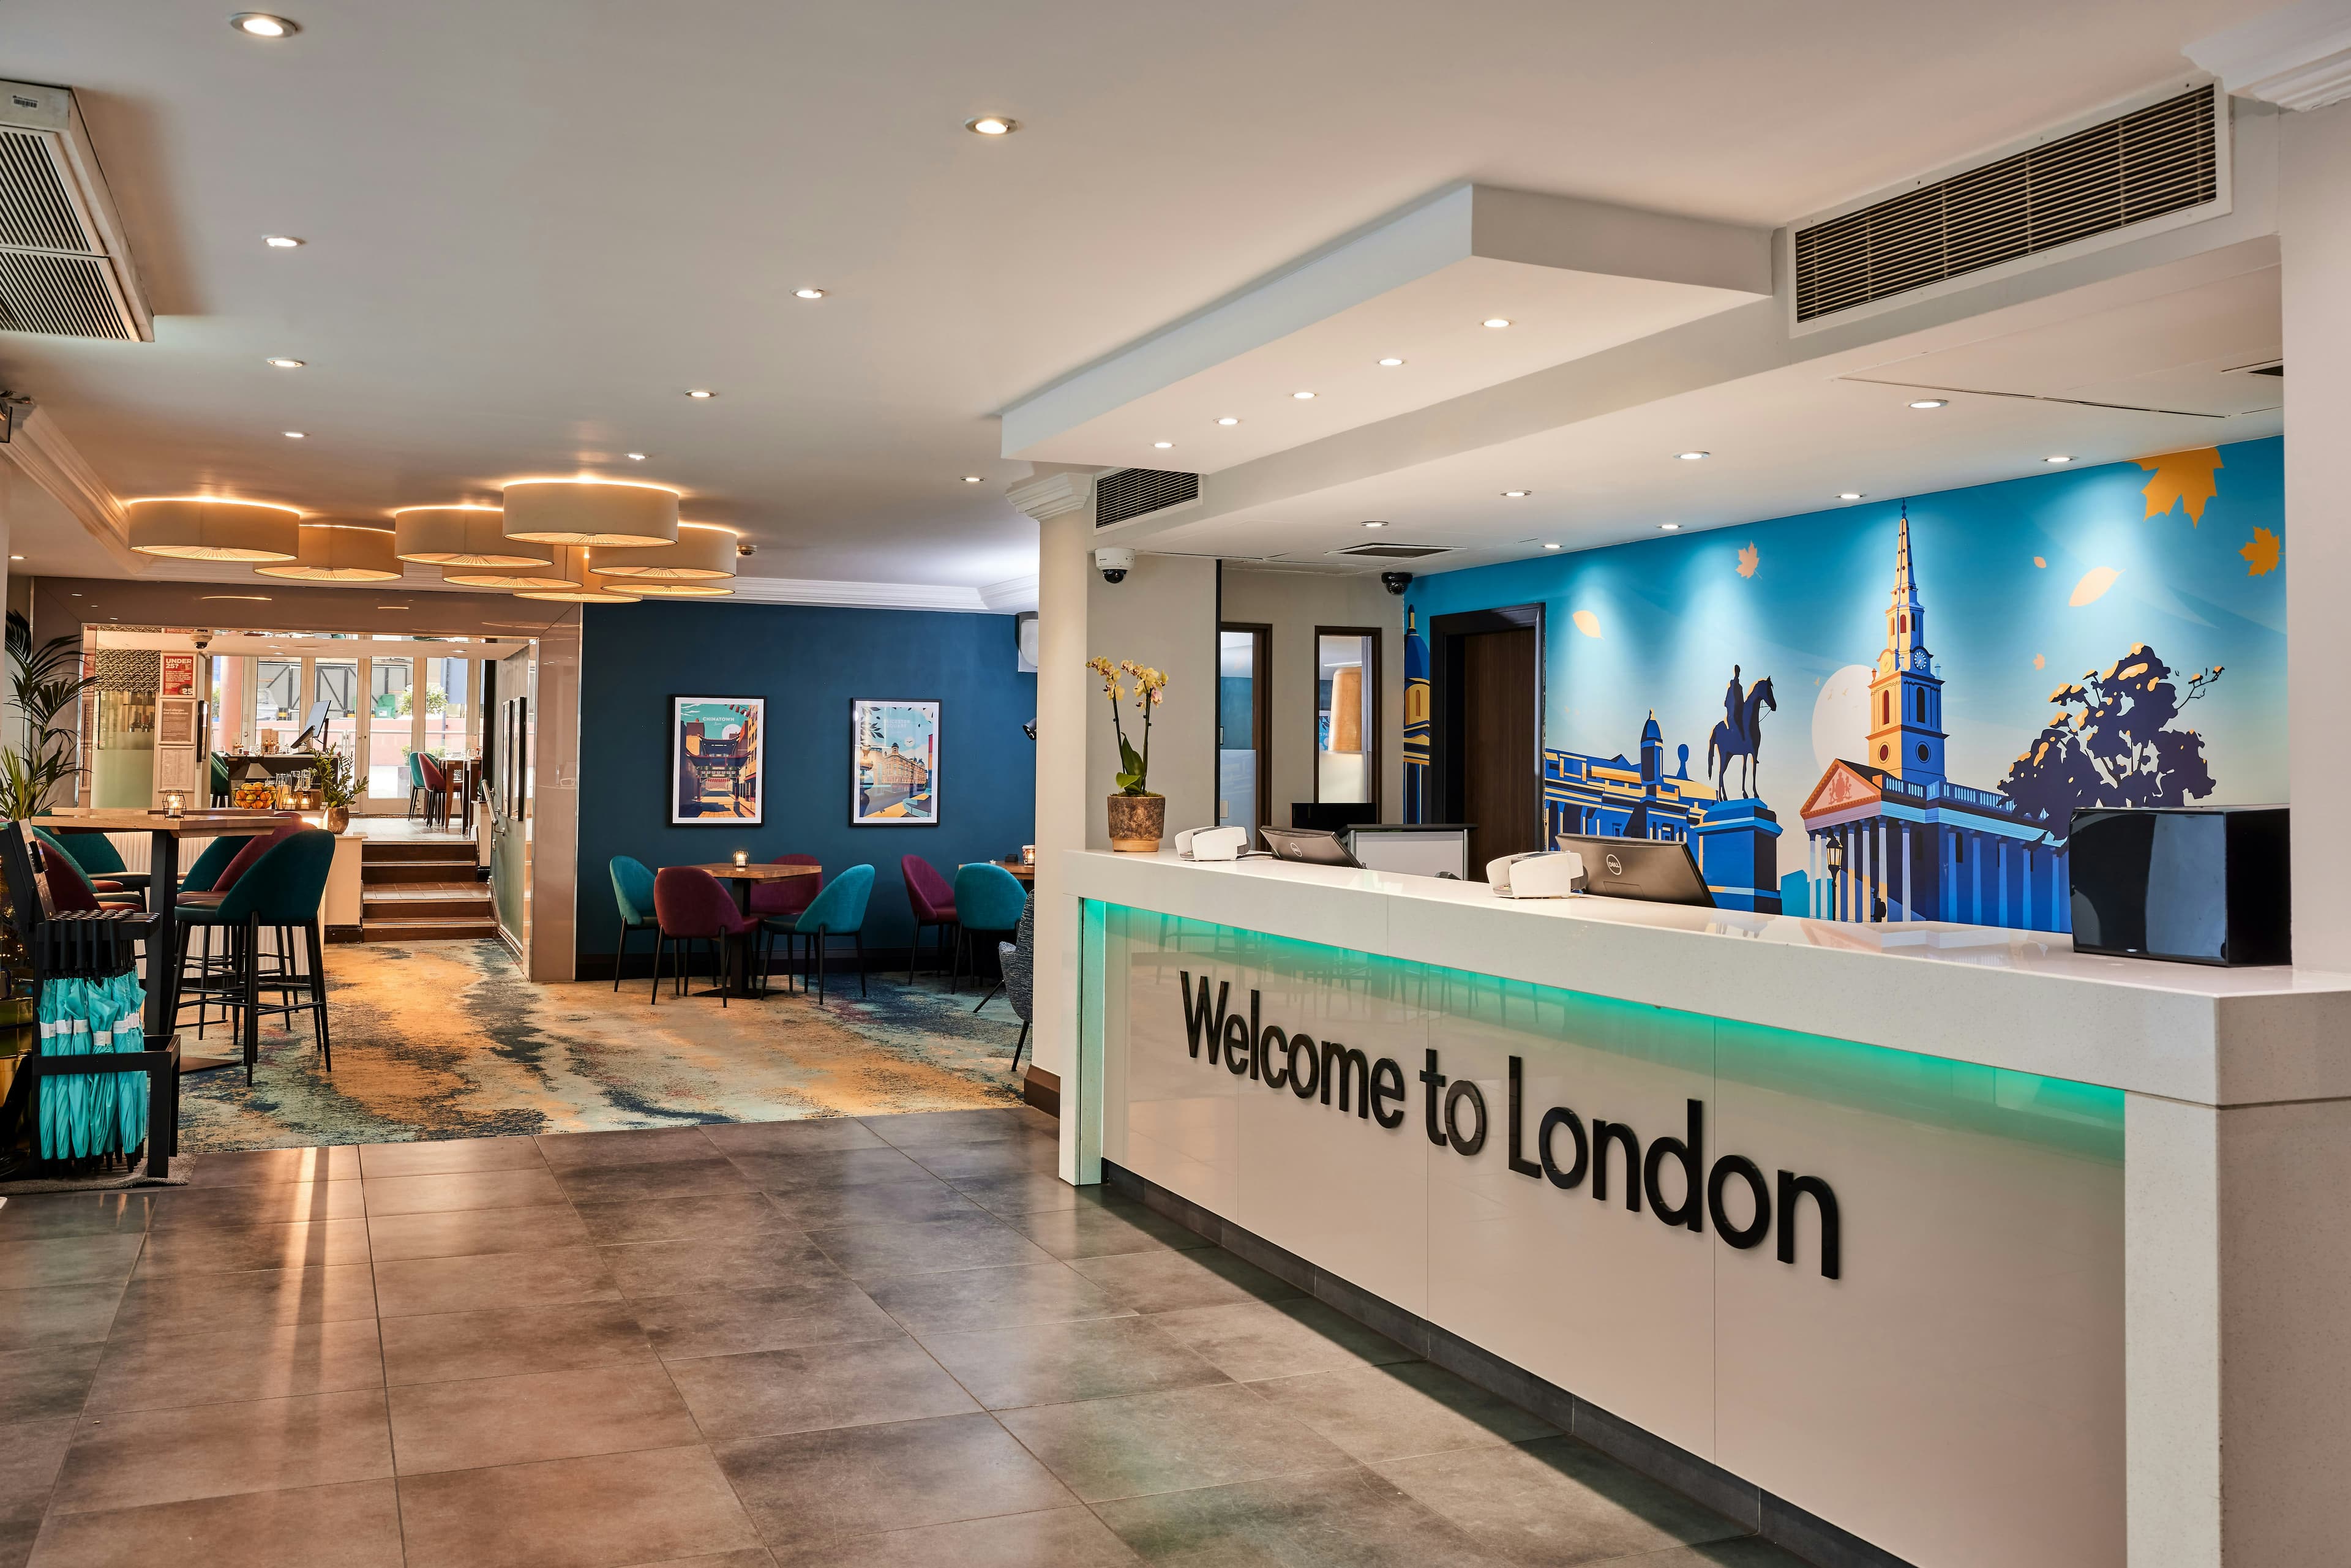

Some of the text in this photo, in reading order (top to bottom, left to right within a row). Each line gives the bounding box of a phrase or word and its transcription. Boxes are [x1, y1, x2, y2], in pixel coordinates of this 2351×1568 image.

[1180, 970, 1840, 1280] Welcome to London
